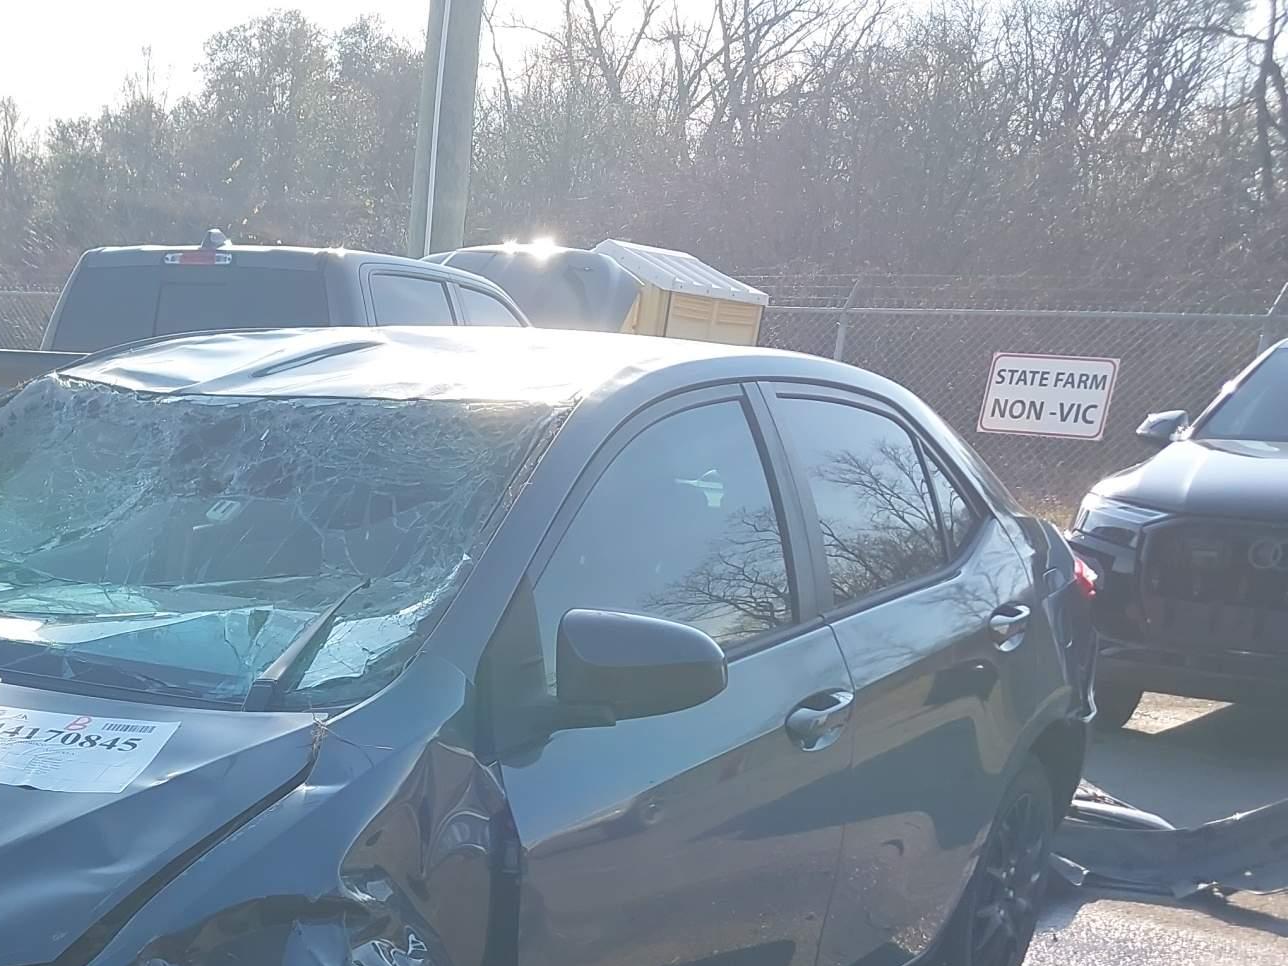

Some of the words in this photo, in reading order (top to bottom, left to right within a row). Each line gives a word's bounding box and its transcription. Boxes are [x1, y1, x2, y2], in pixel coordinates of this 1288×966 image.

[995, 368, 1050, 387] STATE
[1053, 372, 1108, 391] FARM
[990, 398, 1045, 420] NON
